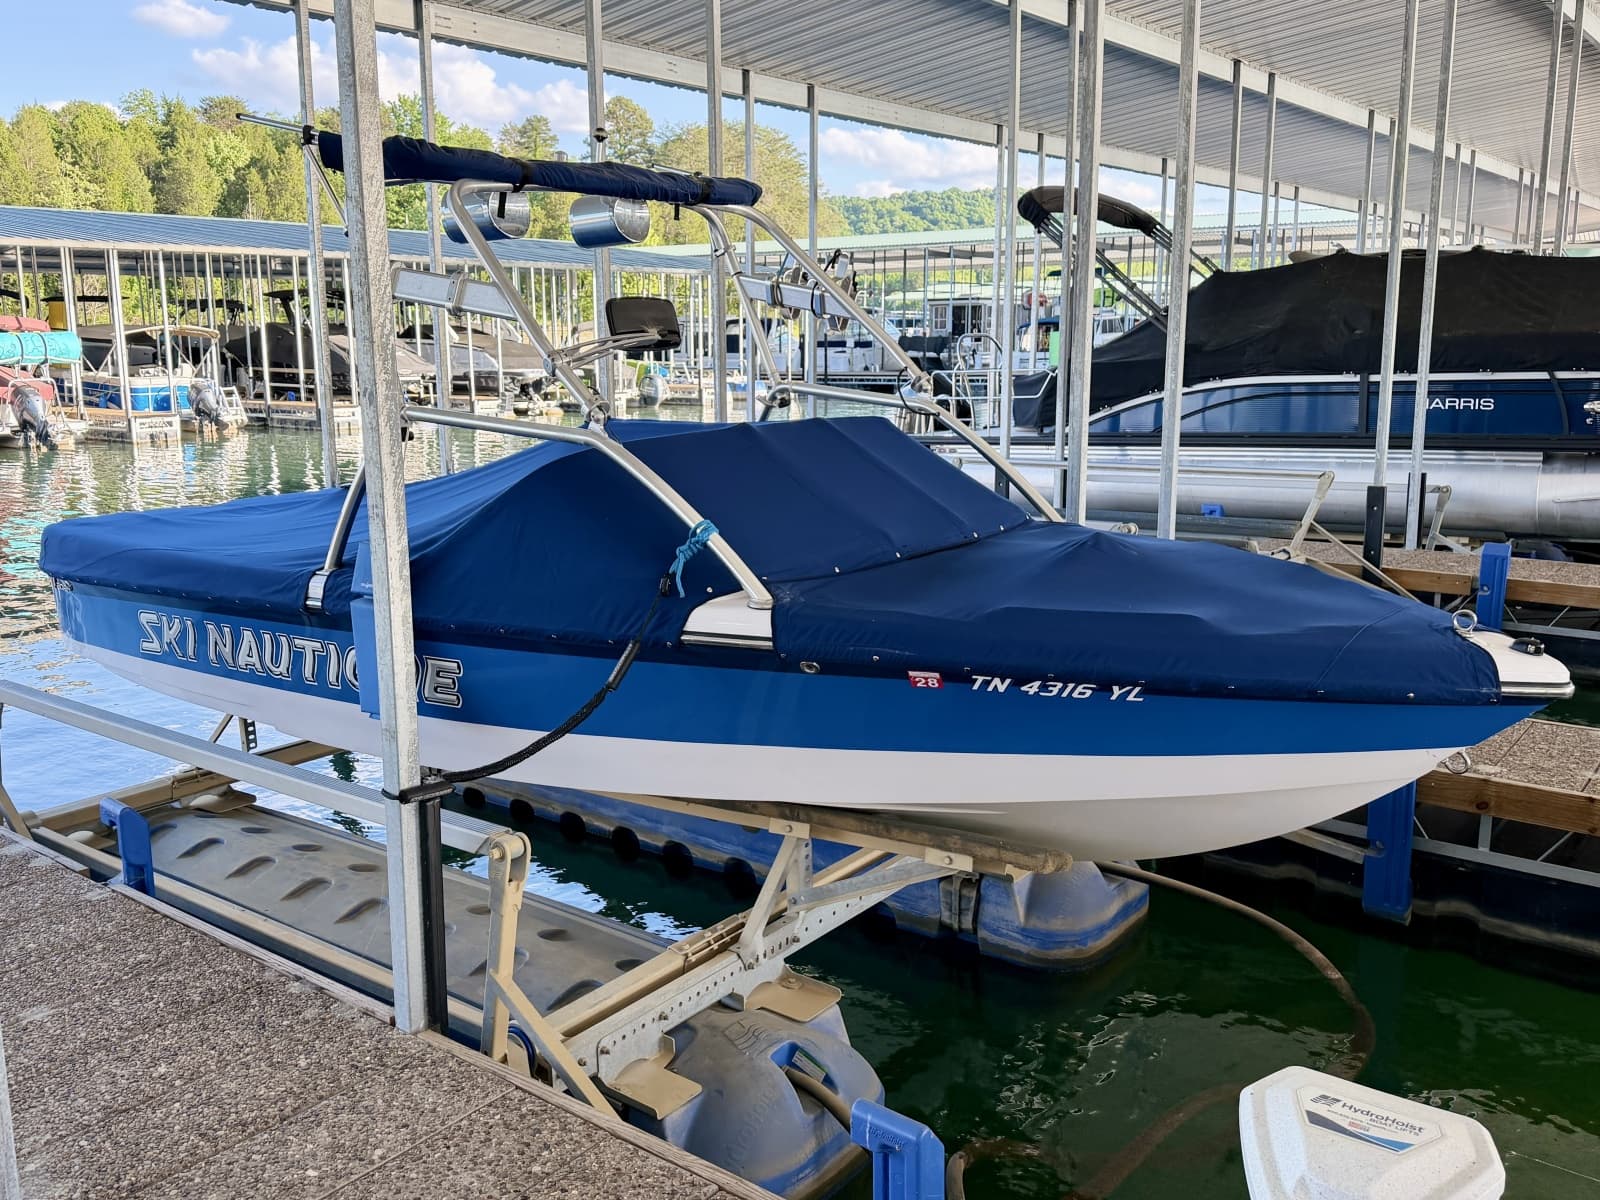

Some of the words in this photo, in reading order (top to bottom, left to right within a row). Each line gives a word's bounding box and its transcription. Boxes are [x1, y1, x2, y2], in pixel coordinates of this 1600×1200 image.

[1425, 397, 1495, 411] ARRIS
[137, 609, 198, 662] SKI
[203, 620, 464, 709] NAUTIE
[970, 675, 1012, 693] TN
[1020, 680, 1096, 699] 4316
[1110, 685, 1145, 702] YL
[1341, 1101, 1426, 1134] HydroHoist
